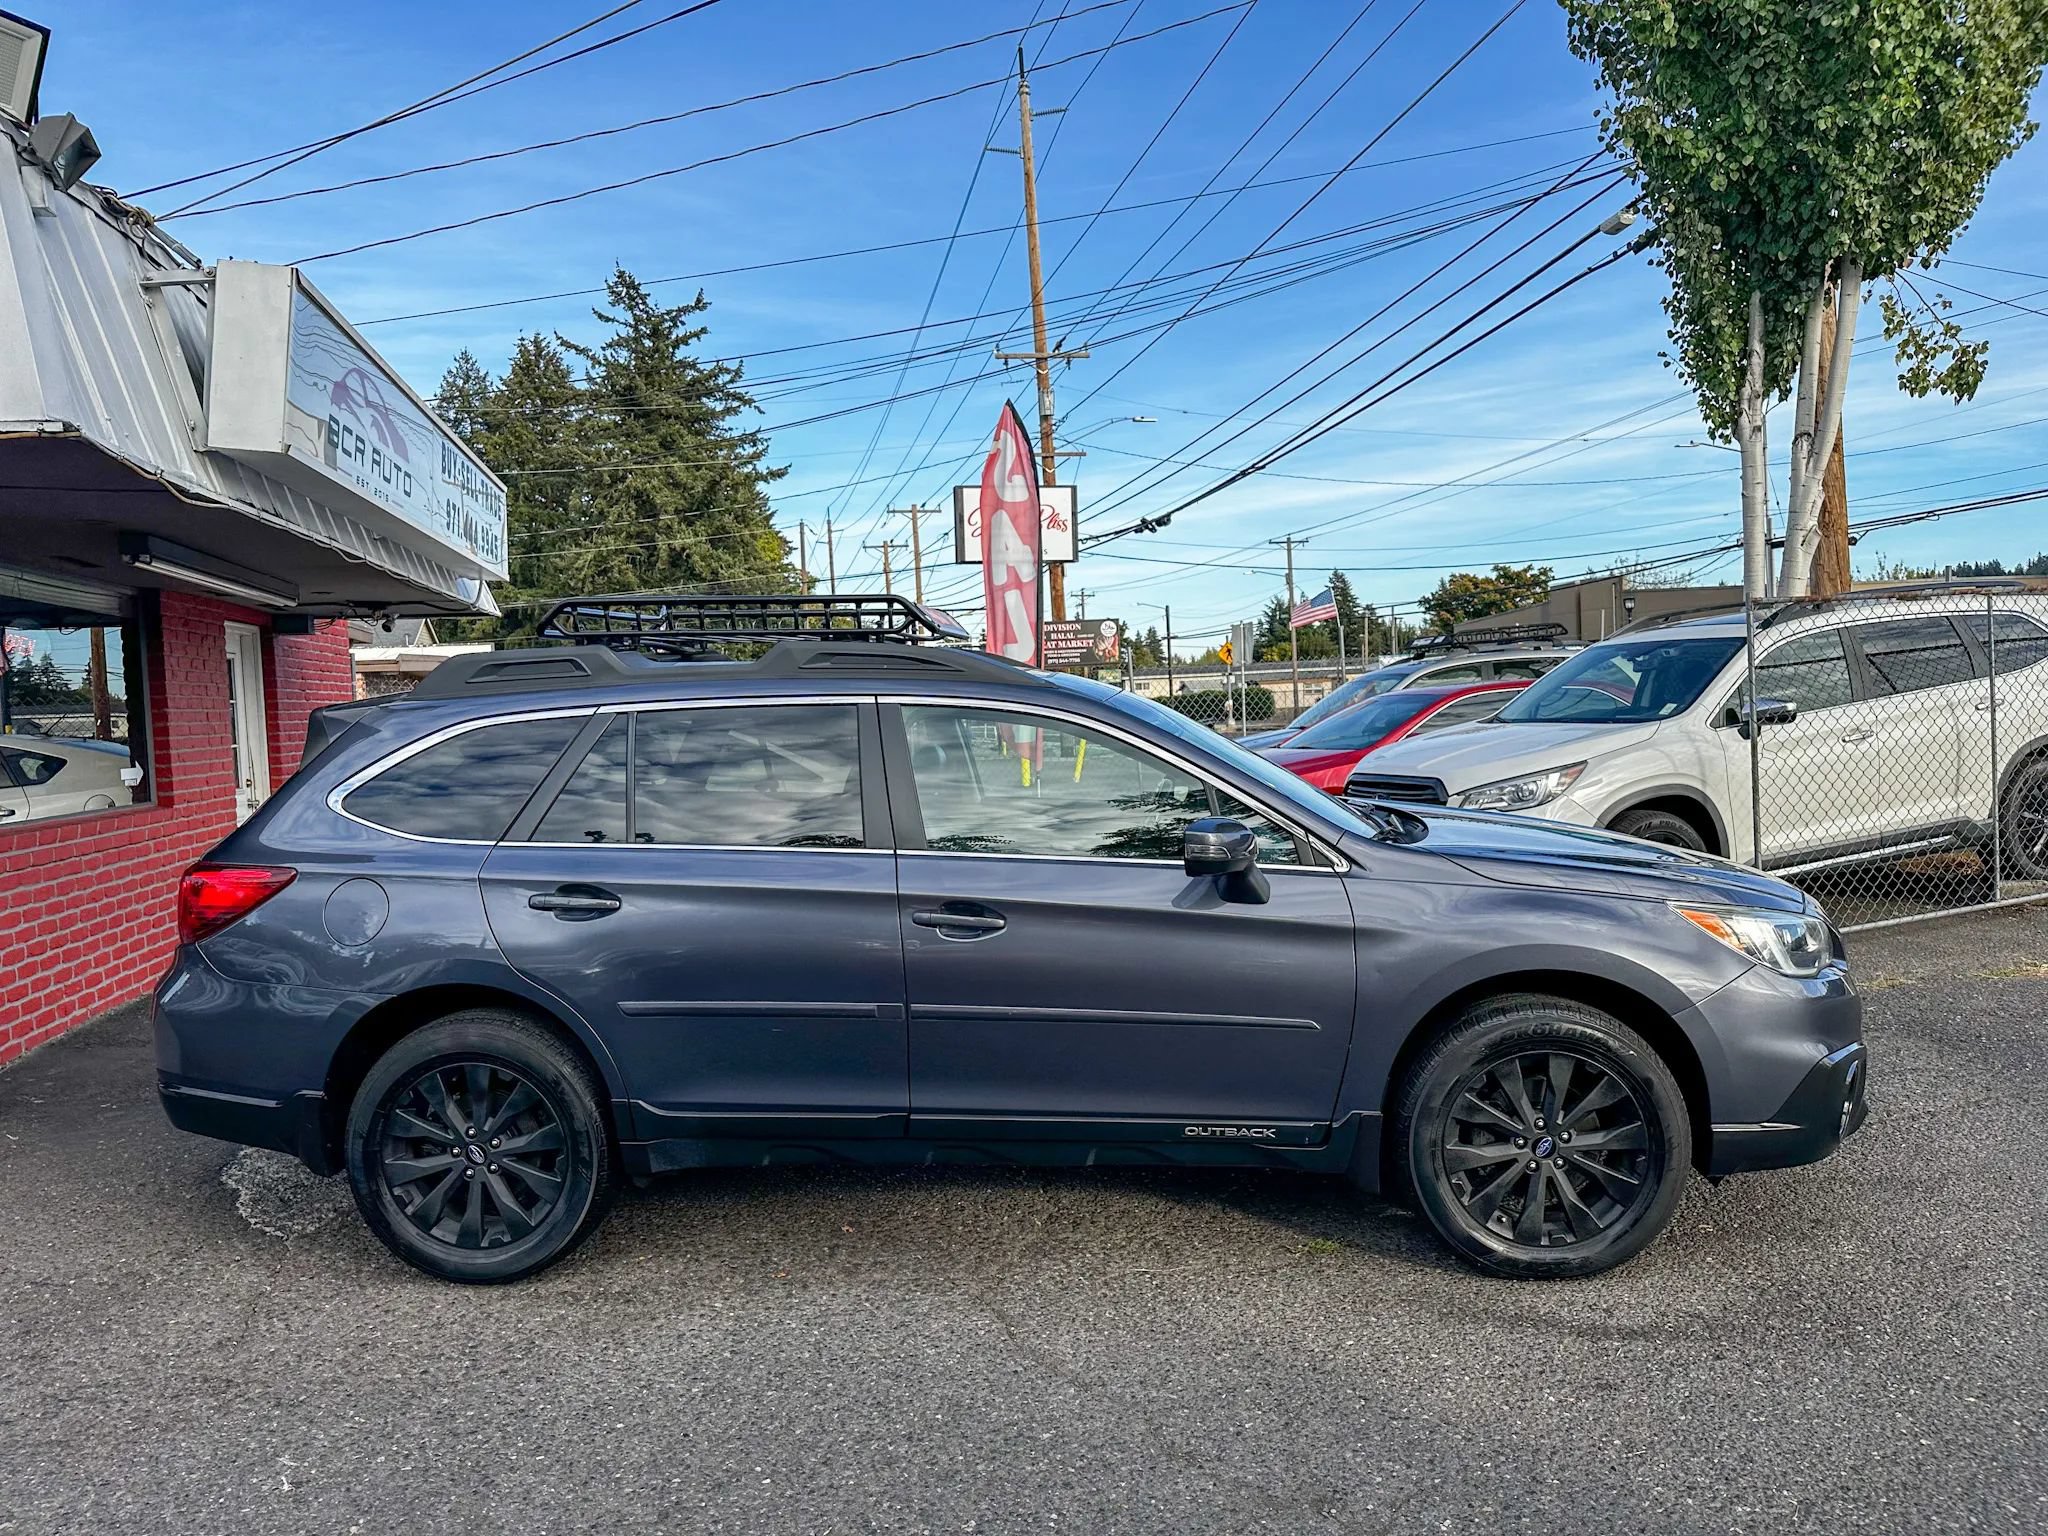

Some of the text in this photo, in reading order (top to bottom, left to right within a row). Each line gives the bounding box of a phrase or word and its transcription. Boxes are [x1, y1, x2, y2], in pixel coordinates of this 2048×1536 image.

[328, 413, 412, 498] BCR AUTO
[1044, 623, 1081, 632] DIVISION
[1050, 632, 1076, 640] HALAL
[1058, 639, 1094, 649] MARKET
[1184, 1126, 1277, 1138] OUTBACK
